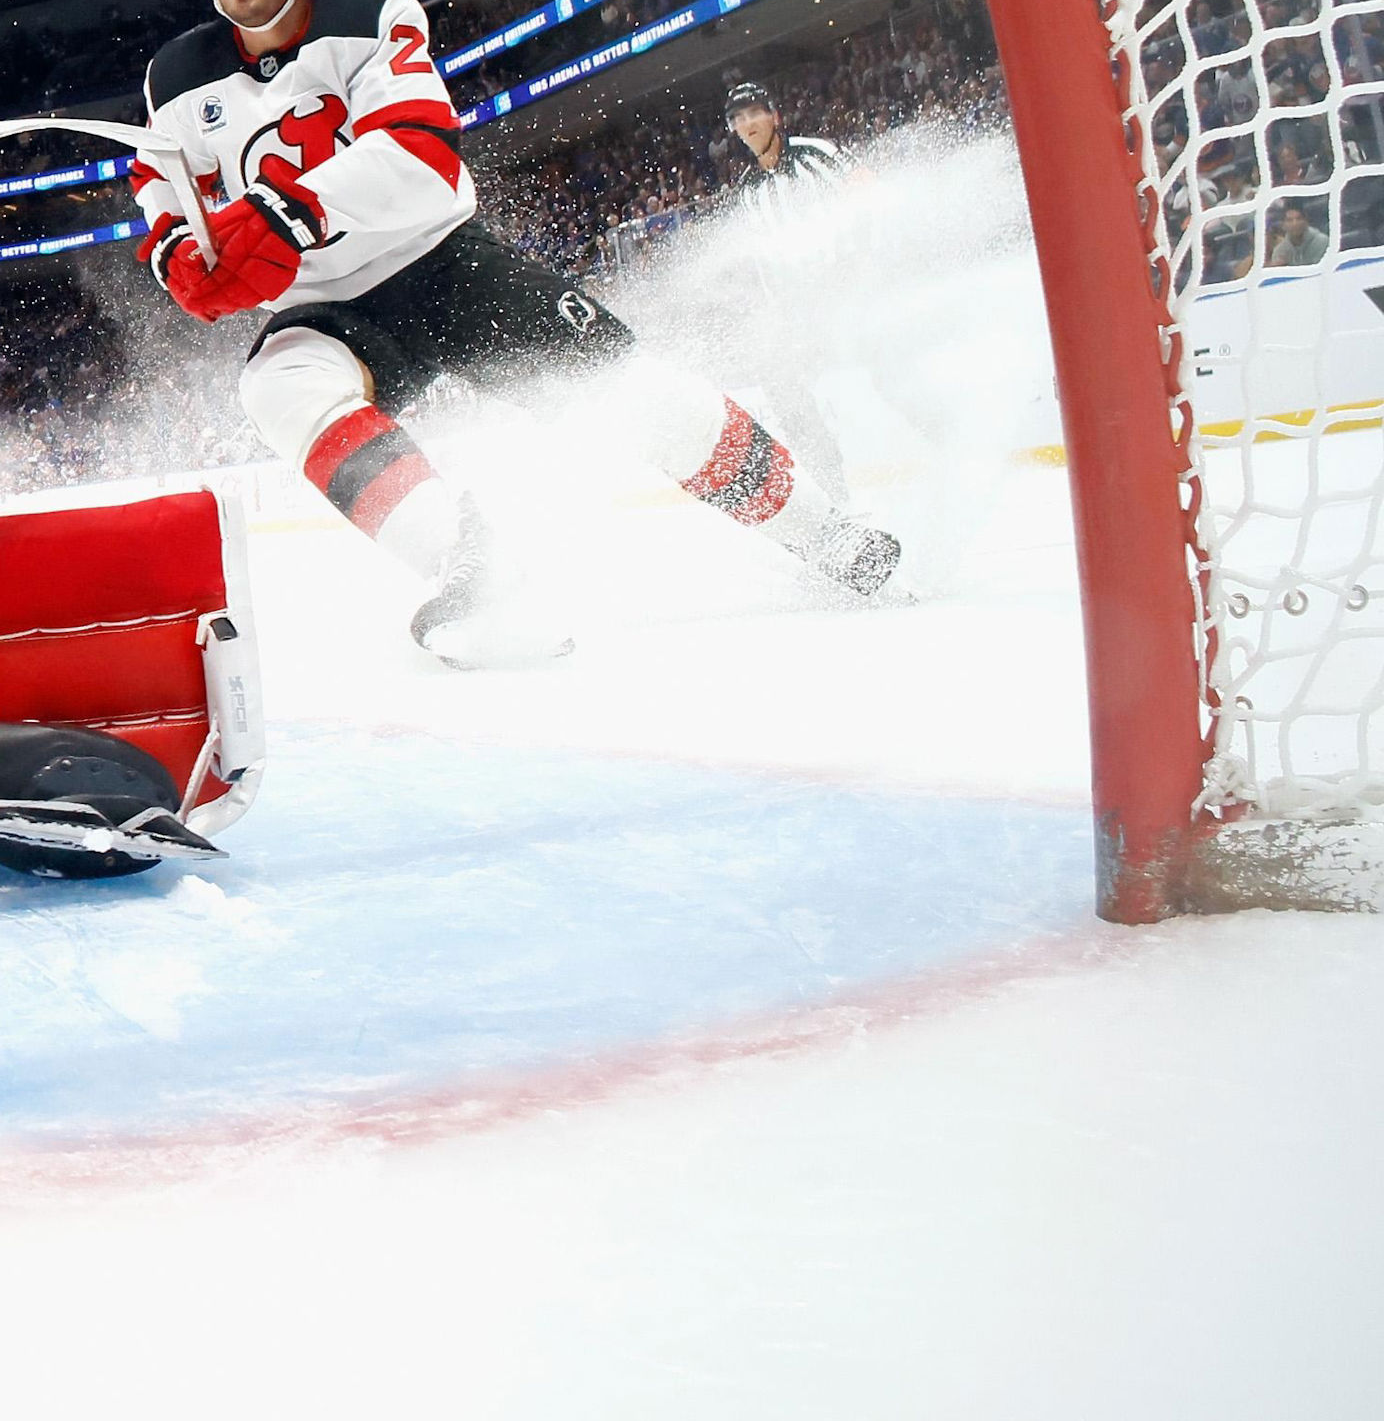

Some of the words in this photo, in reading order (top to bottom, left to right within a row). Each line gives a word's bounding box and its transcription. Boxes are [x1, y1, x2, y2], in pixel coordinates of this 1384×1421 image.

[445, 44, 484, 74] EXPERIENCE
[484, 33, 505, 54] MORE
[529, 78, 549, 96] UBS
[549, 64, 580, 87] ARENA
[581, 57, 592, 73] IS
[592, 41, 630, 67] BETTER
[631, 10, 695, 50] #WITHAMEX
[9, 178, 33, 191] MORE
[1, 243, 38, 258] BETTER
